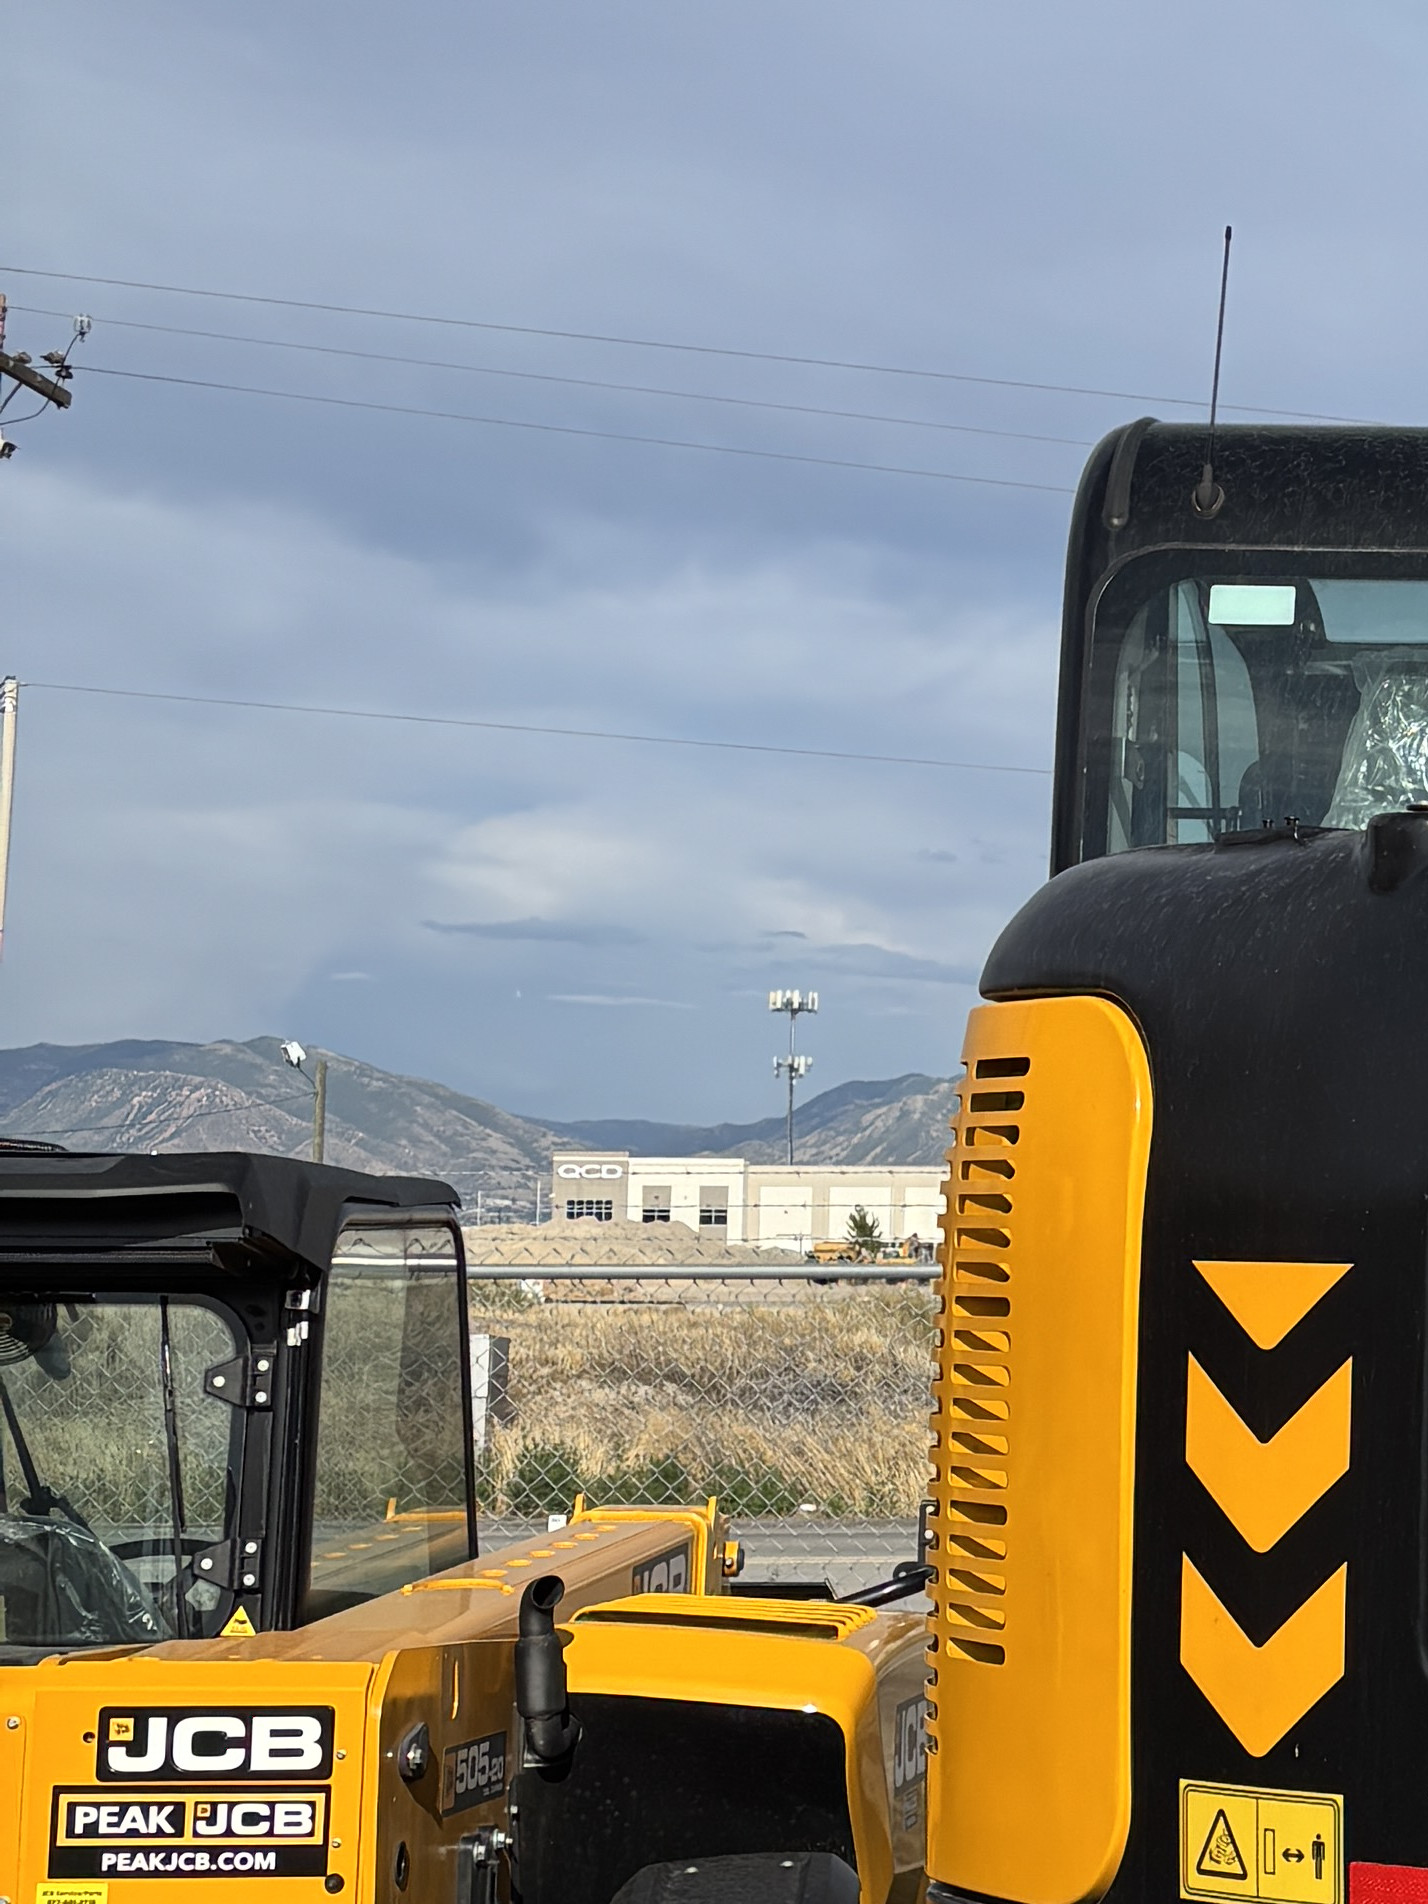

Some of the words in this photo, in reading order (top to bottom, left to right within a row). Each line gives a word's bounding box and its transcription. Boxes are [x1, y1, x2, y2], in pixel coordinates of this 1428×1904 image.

[557, 1164, 623, 1179] QCD
[107, 1716, 323, 1773] JCB
[74, 1805, 175, 1835] PEAK
[195, 1803, 313, 1836] JCB
[101, 1852, 277, 1872] PEAKJCB.COM
